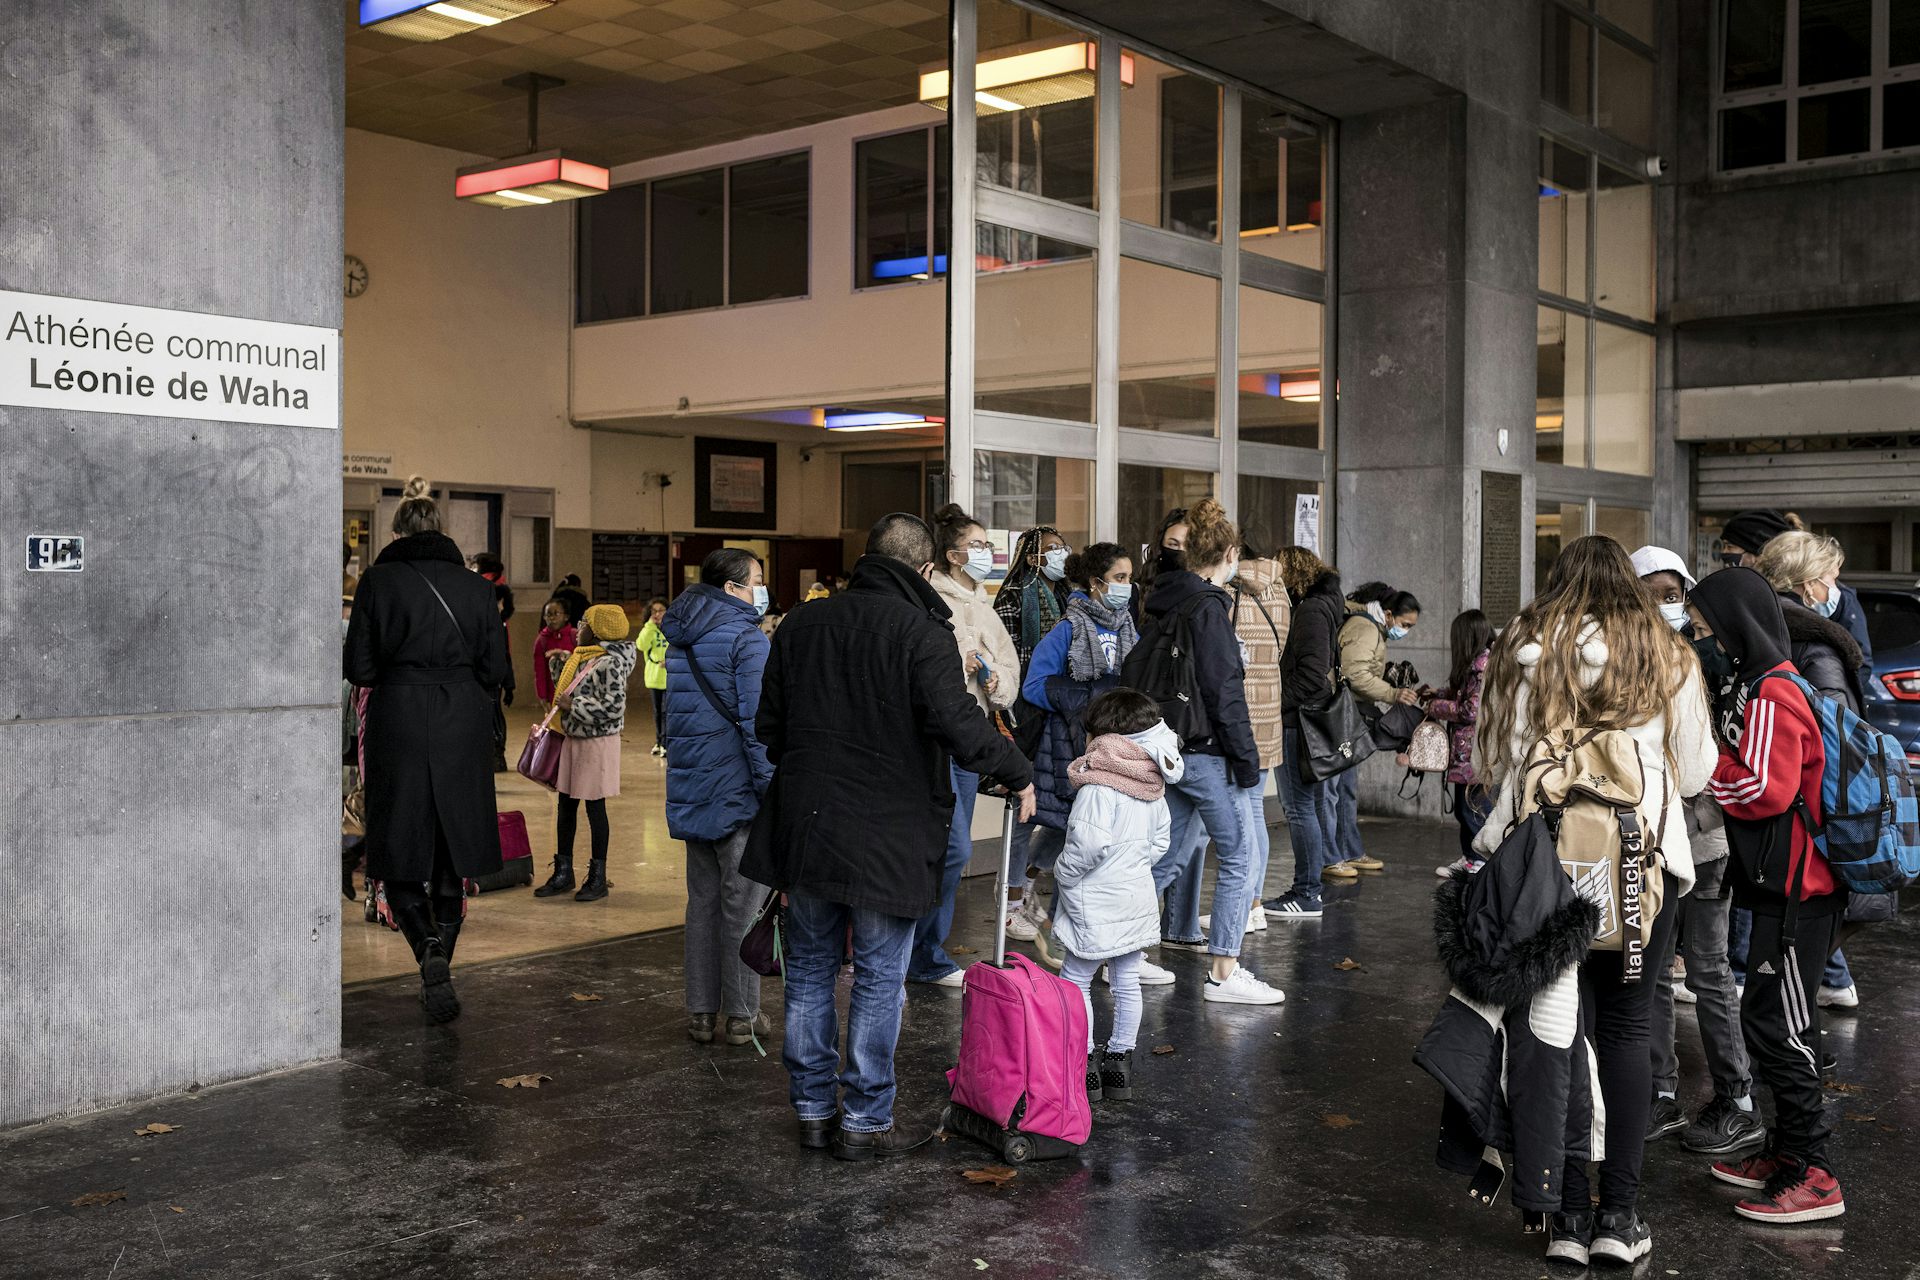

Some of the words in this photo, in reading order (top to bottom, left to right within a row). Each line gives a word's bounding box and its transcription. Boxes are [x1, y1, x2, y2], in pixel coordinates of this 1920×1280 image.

[6, 311, 154, 354] Athénée
[167, 335, 326, 371] communal
[30, 358, 155, 397] Léonie
[167, 372, 208, 402] de
[220, 374, 309, 410] Waha
[350, 455, 392, 464] communal
[351, 465, 362, 473] de
[363, 466, 388, 474] Waha
[1622, 855, 1641, 930] Attack
[1624, 939, 1642, 983] itan
